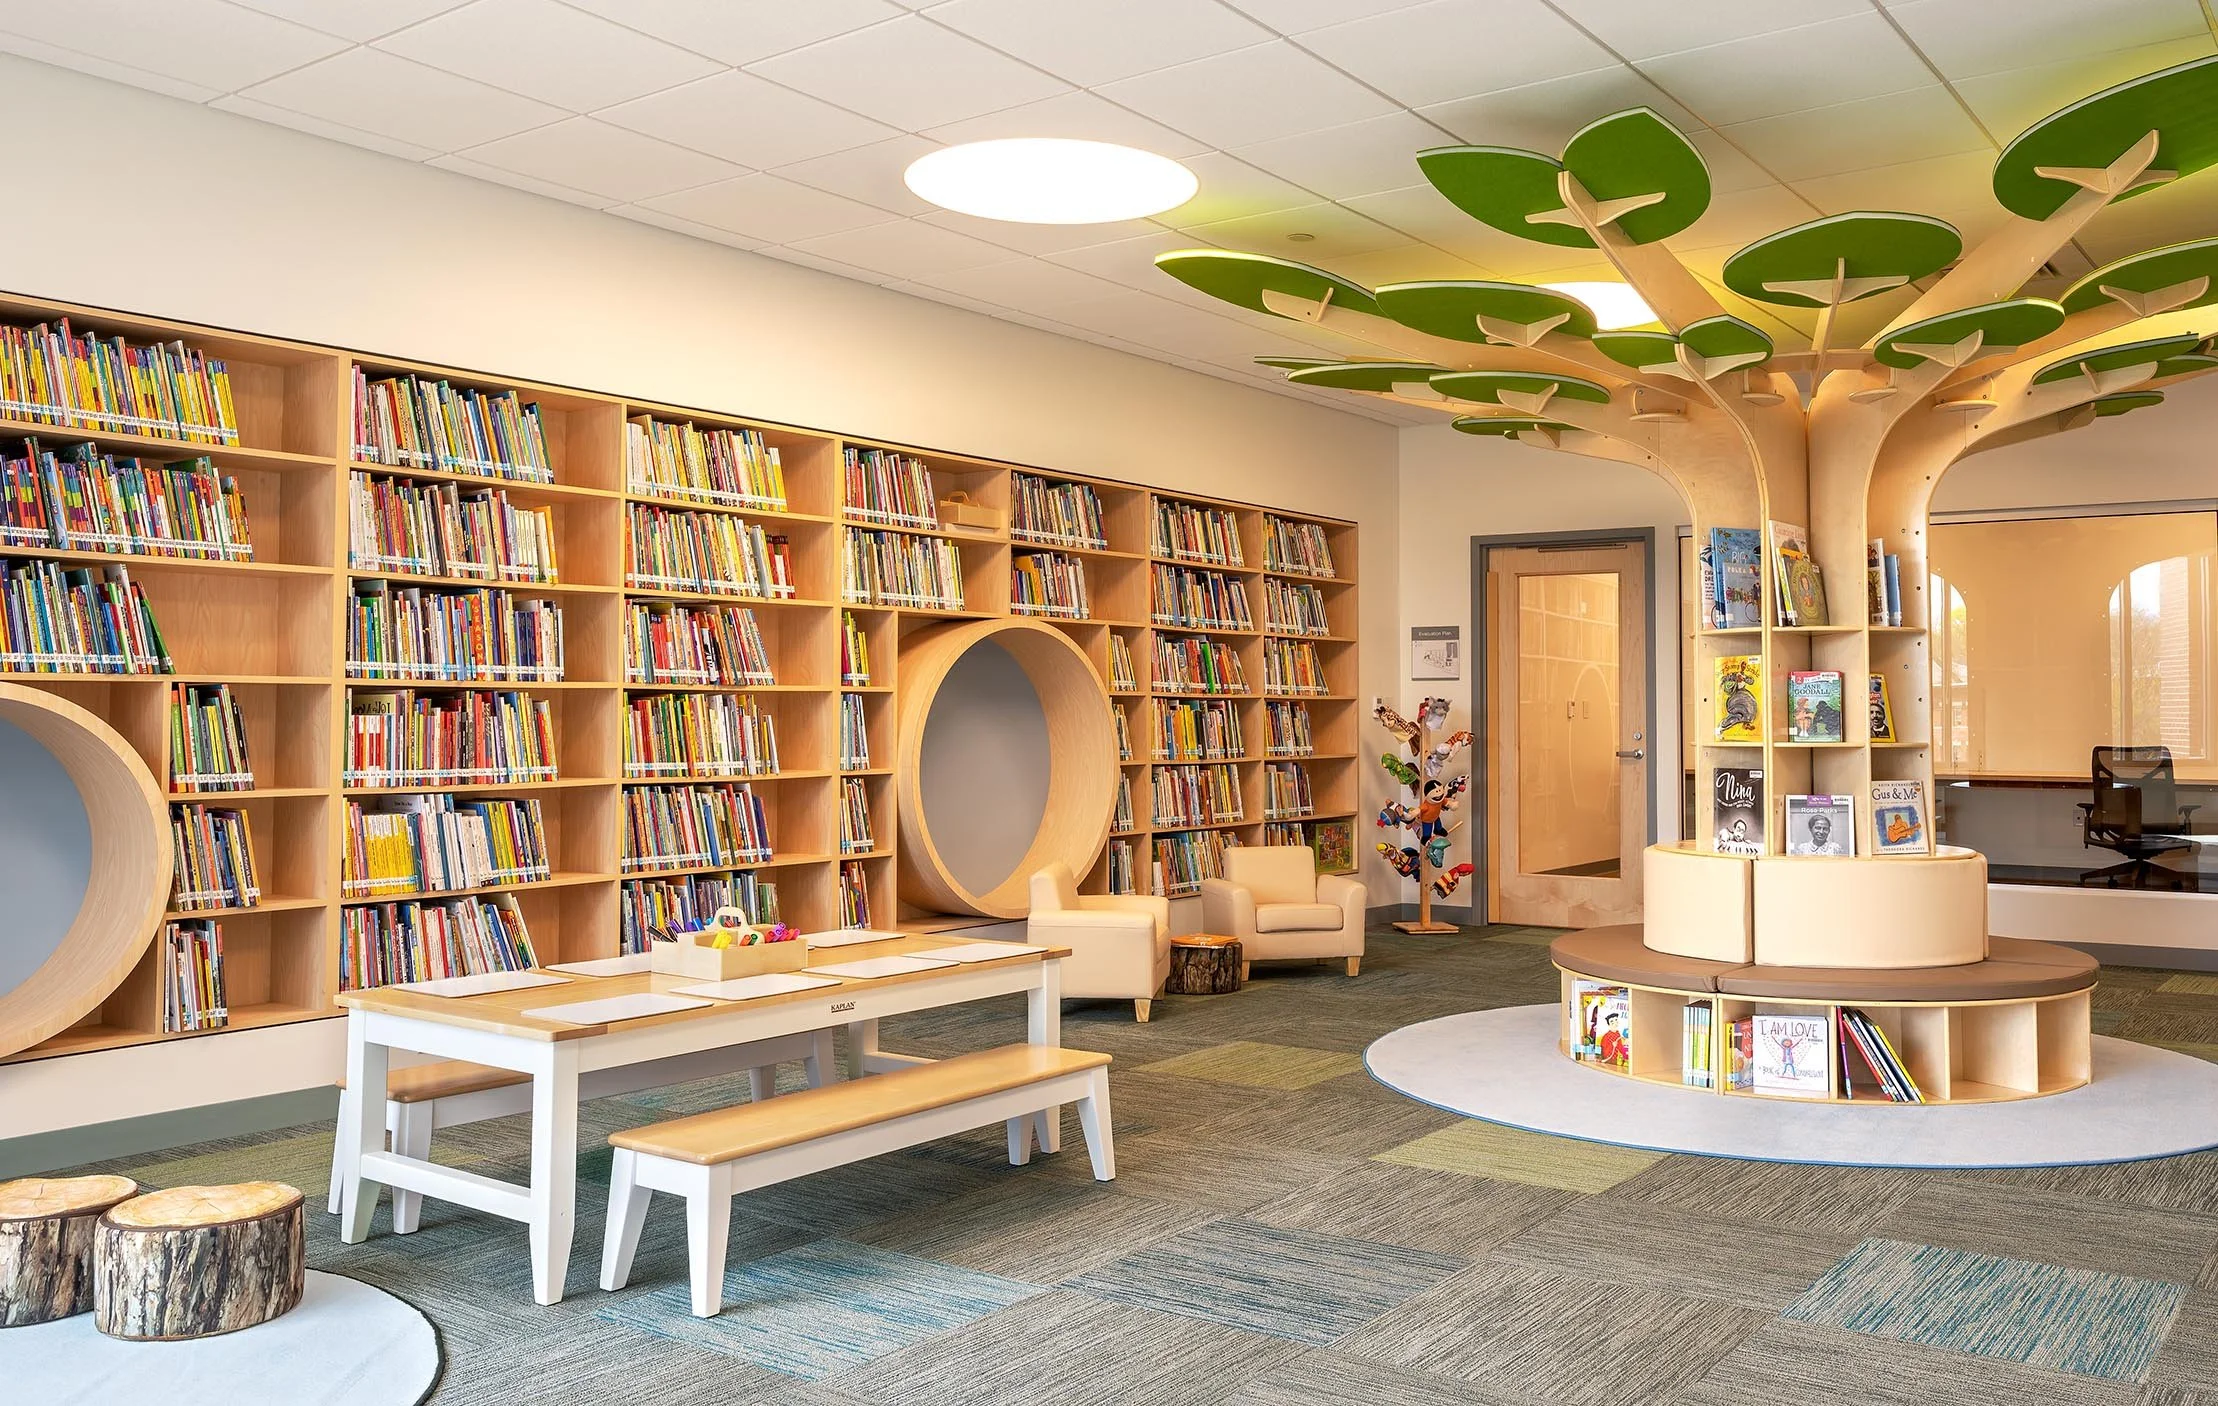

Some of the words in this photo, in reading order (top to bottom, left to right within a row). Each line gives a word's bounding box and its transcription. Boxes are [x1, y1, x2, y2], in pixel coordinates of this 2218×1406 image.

[474, 606, 484, 665] SEASON
[1716, 772, 1755, 801] Nina
[1872, 788, 1891, 800] Gus
[1892, 788, 1902, 800] &
[1903, 788, 1917, 800] Me
[831, 1001, 855, 1011] KAPLAN
[1759, 1019, 1766, 1035] I
[1770, 1021, 1788, 1035] AM
[1791, 1021, 1818, 1037] LOVE
